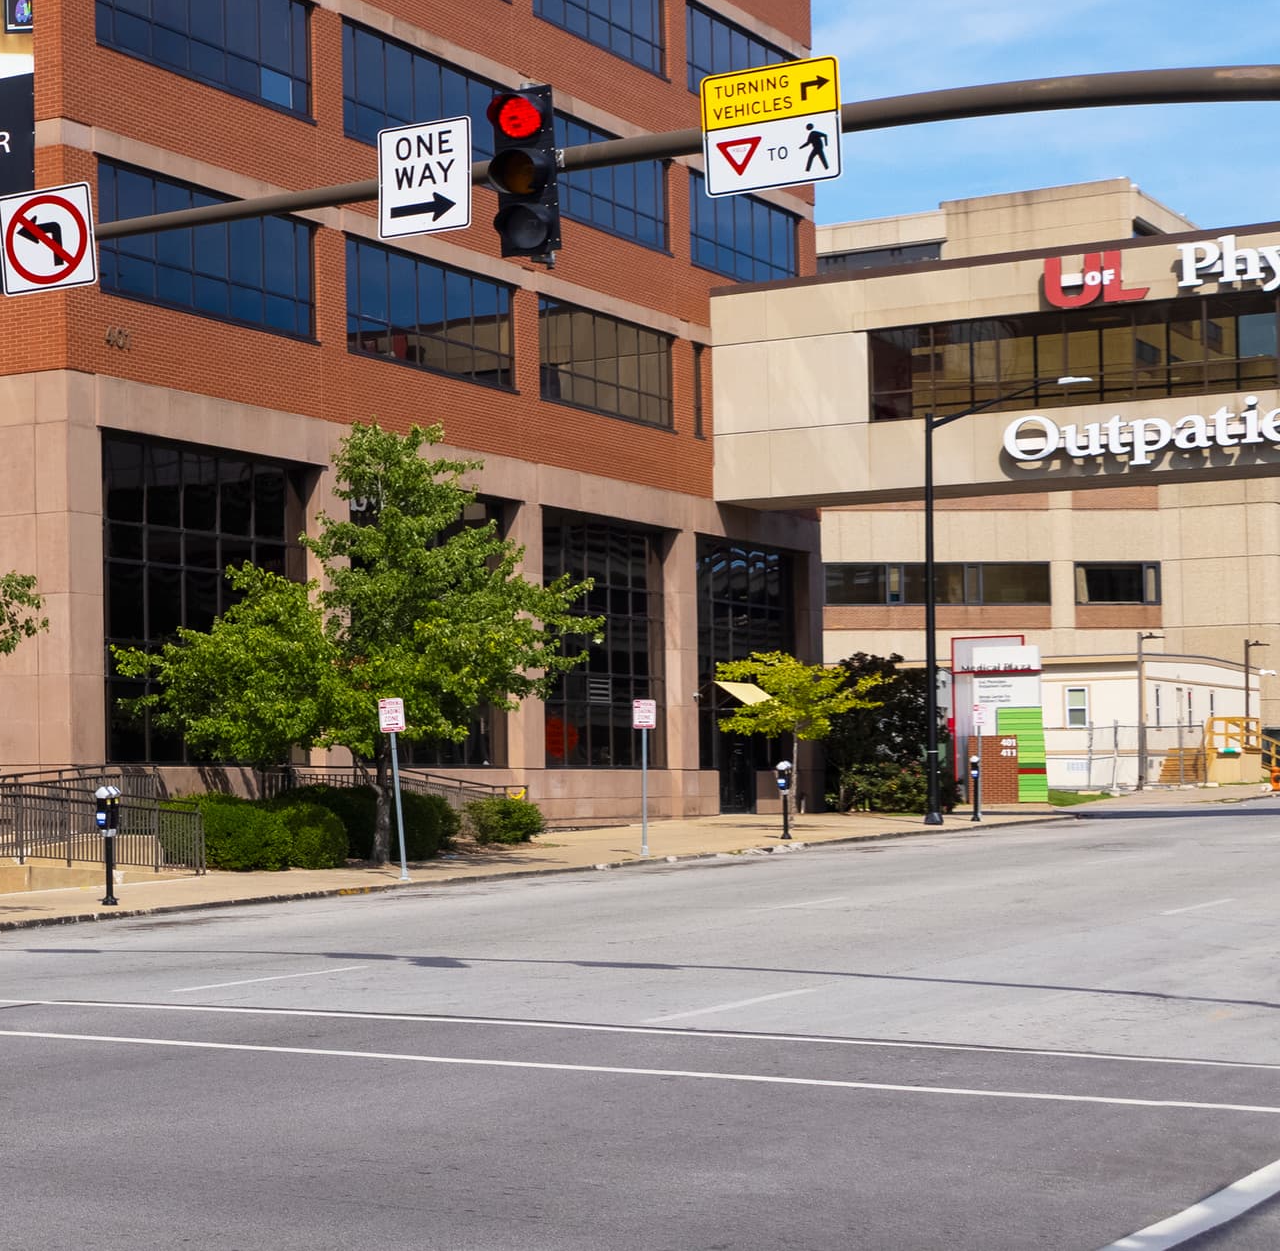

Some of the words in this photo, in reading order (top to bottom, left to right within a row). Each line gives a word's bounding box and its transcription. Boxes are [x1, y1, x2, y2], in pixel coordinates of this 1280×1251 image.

[714, 75, 790, 100] TURNING
[713, 96, 793, 121] VEHICLES
[395, 130, 453, 161] ONE
[768, 146, 789, 162] TO
[395, 158, 455, 191] WAY
[961, 663, 1000, 672] Medical
[1004, 663, 1031, 671] Plaza
[1000, 738, 1016, 747] 401
[1000, 749, 1016, 757] 411
